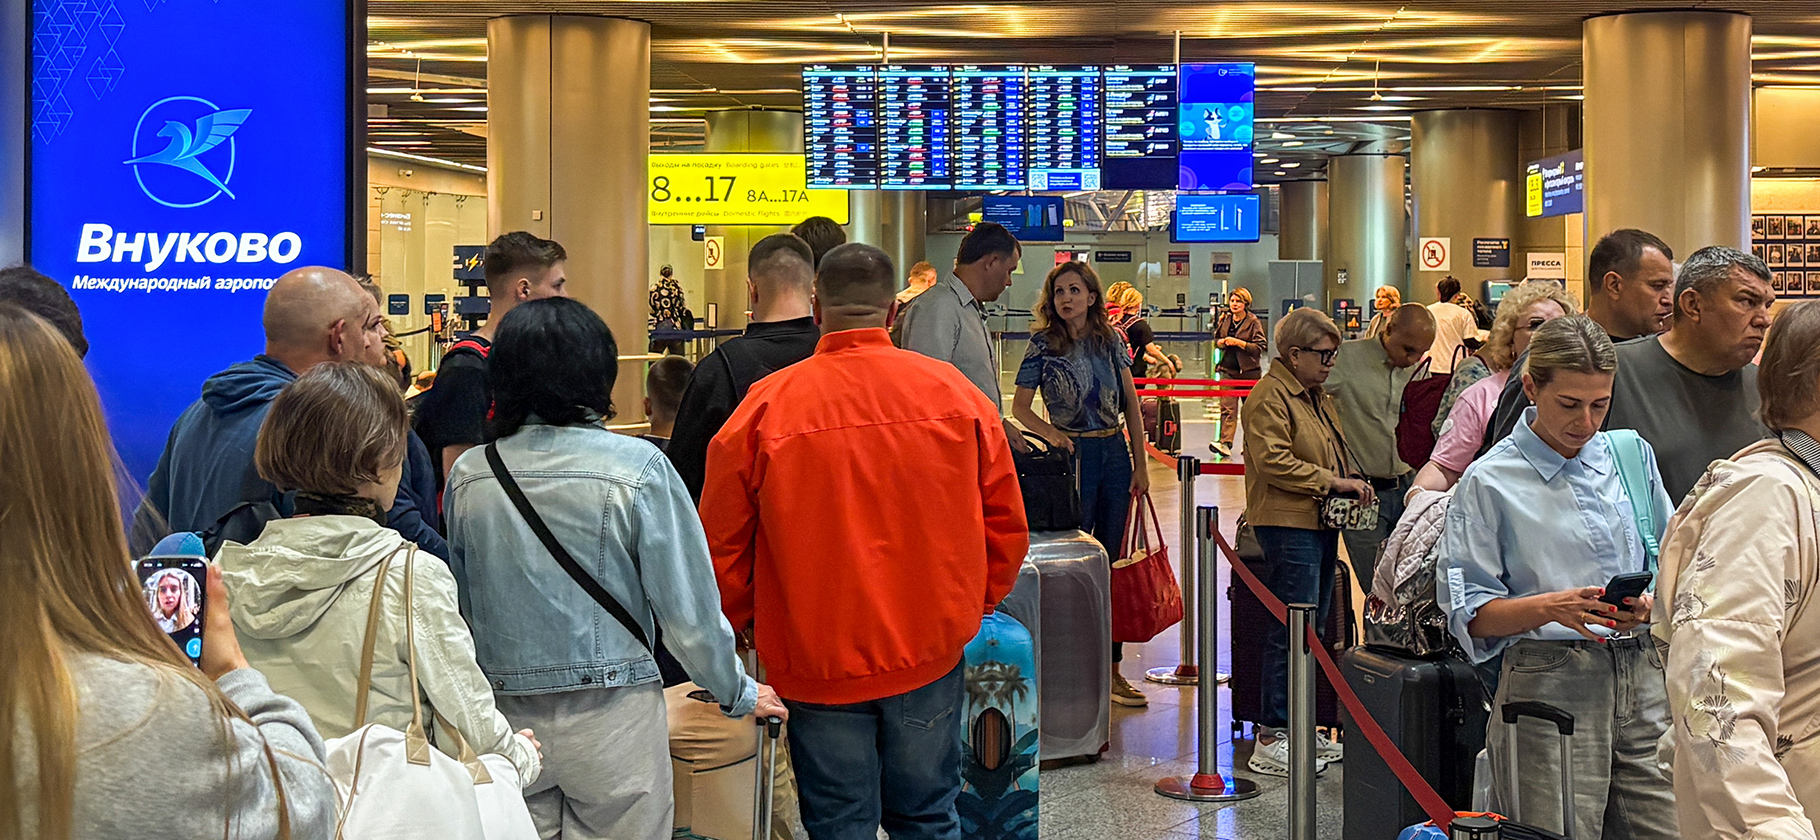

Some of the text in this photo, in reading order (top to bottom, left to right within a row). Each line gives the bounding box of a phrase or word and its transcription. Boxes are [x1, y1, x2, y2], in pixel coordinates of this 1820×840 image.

[651, 176, 737, 202] 8...17
[76, 223, 302, 272] Внуково
[72, 275, 277, 294] Международный аэропо
